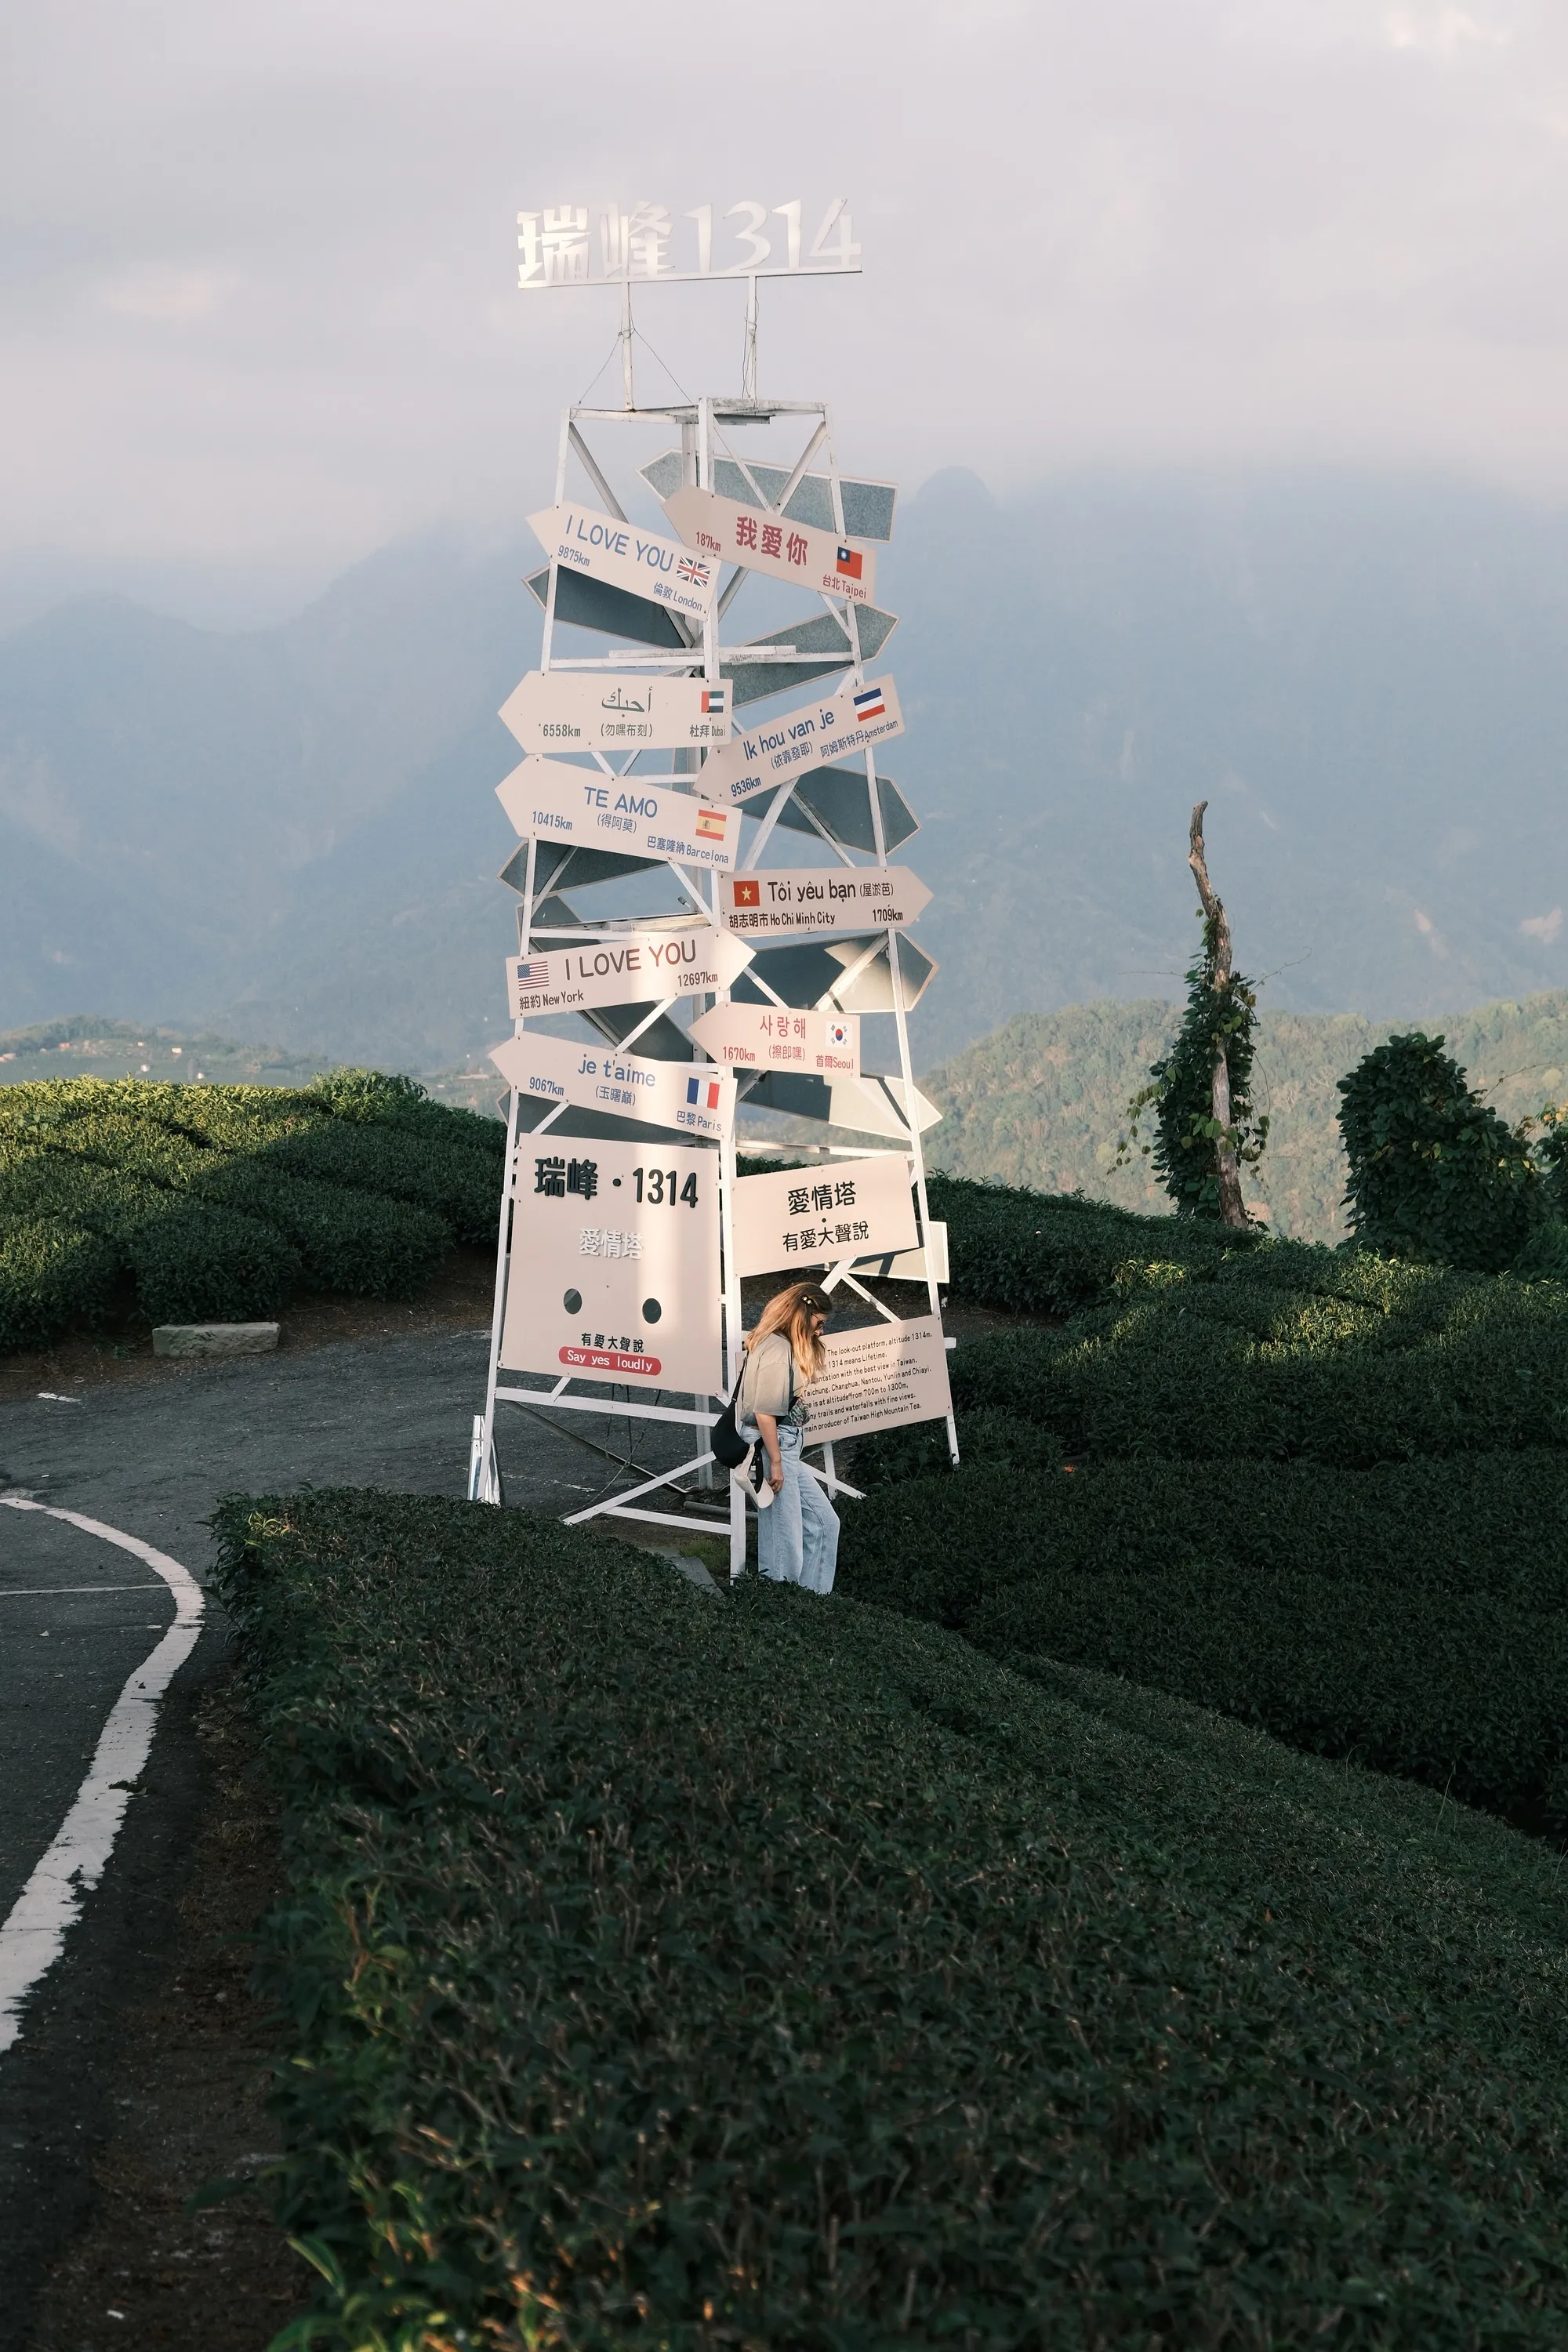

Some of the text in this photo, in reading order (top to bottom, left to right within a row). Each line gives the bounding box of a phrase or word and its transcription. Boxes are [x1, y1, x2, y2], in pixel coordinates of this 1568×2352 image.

[517, 198, 862, 281] 瑞峰 1314
[566, 514, 674, 572] I LOVE YOU
[695, 532, 721, 552] 187km
[736, 516, 808, 565] 我愛你
[557, 545, 590, 568] 9875km
[652, 582, 702, 612] 倫敦 London
[822, 573, 867, 599] 台北 Taipei
[601, 686, 653, 717] أحبك
[543, 724, 581, 738] 6558km
[689, 724, 726, 738] 杜拜 Dubai
[743, 709, 835, 760] Ik hou van je
[820, 720, 898, 759] 阿姆斯特丹 Amsterdam
[731, 776, 761, 797] 9536km
[584, 786, 659, 818] TE AMO
[532, 811, 573, 831] 10415km
[647, 836, 729, 864] 巴塞隆納 Barcelona
[768, 880, 792, 902] Tôi
[797, 880, 824, 902] yêu
[829, 879, 856, 902] bạn
[728, 911, 836, 929] 胡志明市 Ho Chi Minh City
[872, 909, 904, 923] 1709km
[565, 939, 697, 981] I LOVE YOU
[677, 971, 719, 988] 12697km
[519, 989, 585, 1011] 紐約 New York
[759, 1014, 807, 1040] 사랑해
[723, 1047, 756, 1062] 1670km
[833, 1057, 855, 1069] Seoul
[578, 1053, 656, 1087] je t'aime
[529, 1076, 564, 1097] 9067km
[677, 1110, 722, 1132] 巴黎 Paris
[534, 1156, 699, 1209] 瑞峰 1314
[787, 1181, 856, 1216] 愛情塔
[579, 1228, 644, 1260] 愛情塔
[782, 1221, 869, 1253] 有愛大聲說
[581, 1332, 644, 1353] 有愛大聲說
[888, 1334, 911, 1345] altitude
[567, 1349, 653, 1373] Say yes loudly
[829, 1359, 844, 1369] 1314
[840, 1369, 853, 1377] with
[863, 1364, 877, 1374] best
[877, 1363, 889, 1371] view
[884, 1371, 901, 1381] Yunlin
[901, 1368, 912, 1377] and
[812, 1399, 818, 1408] is
[818, 1398, 826, 1406] at
[863, 1387, 880, 1396] 700m
[817, 1409, 834, 1418] trails
[834, 1405, 844, 1414] and
[845, 1399, 873, 1414] waterfalls
[873, 1397, 887, 1406] with
[804, 1424, 818, 1433] main
[818, 1419, 843, 1431] producer
[843, 1416, 850, 1425] of
[850, 1413, 870, 1423] Taiwan
[870, 1409, 884, 1419] High
[884, 1404, 909, 1416] Mountain
